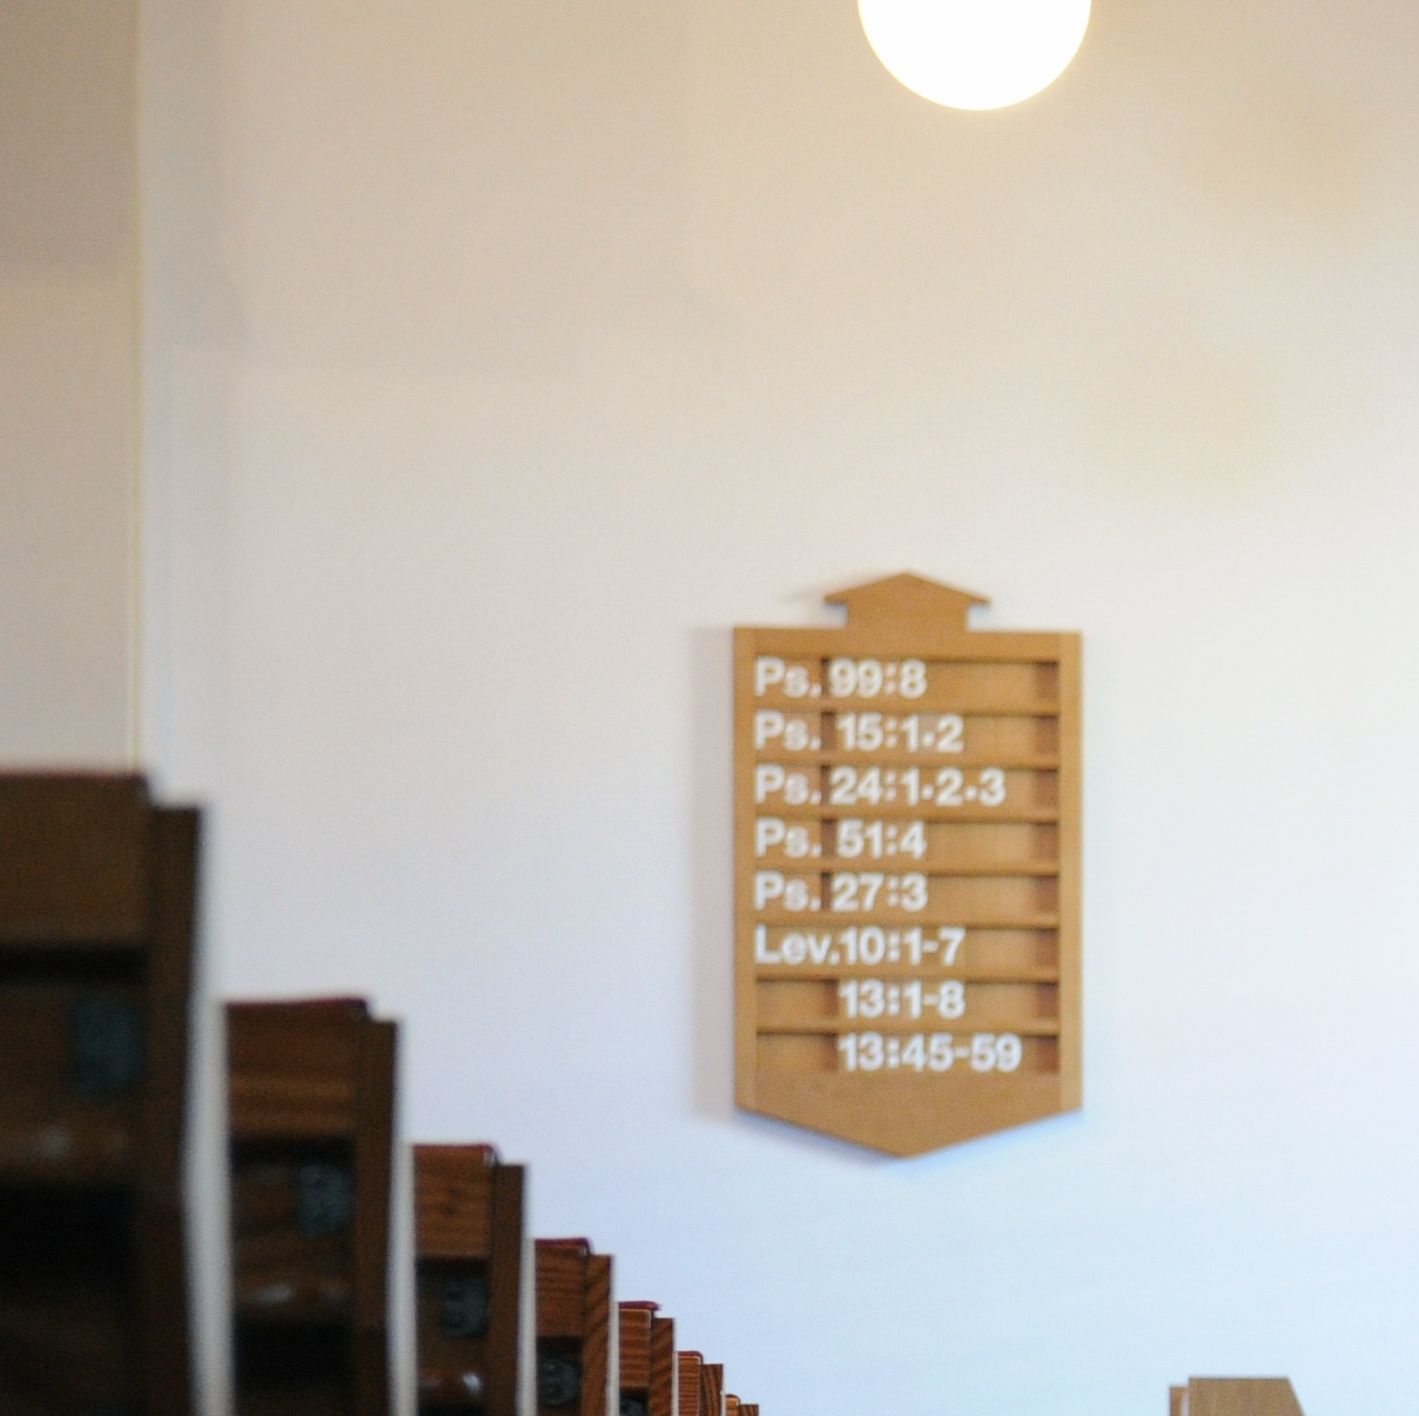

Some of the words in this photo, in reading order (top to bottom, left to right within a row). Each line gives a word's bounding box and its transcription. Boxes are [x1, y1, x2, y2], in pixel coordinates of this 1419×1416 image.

[754, 656, 822, 699] Ps.
[828, 657, 927, 699] 99:8
[754, 709, 822, 751] Ps.
[754, 763, 822, 805] Ps.
[754, 817, 822, 858] Ps.
[837, 819, 927, 859] 51:4
[754, 870, 822, 911] Ps.
[831, 872, 929, 912] 27:3
[838, 979, 966, 1020] 13:1-8
[838, 1031, 1023, 1073] 13:45-59
